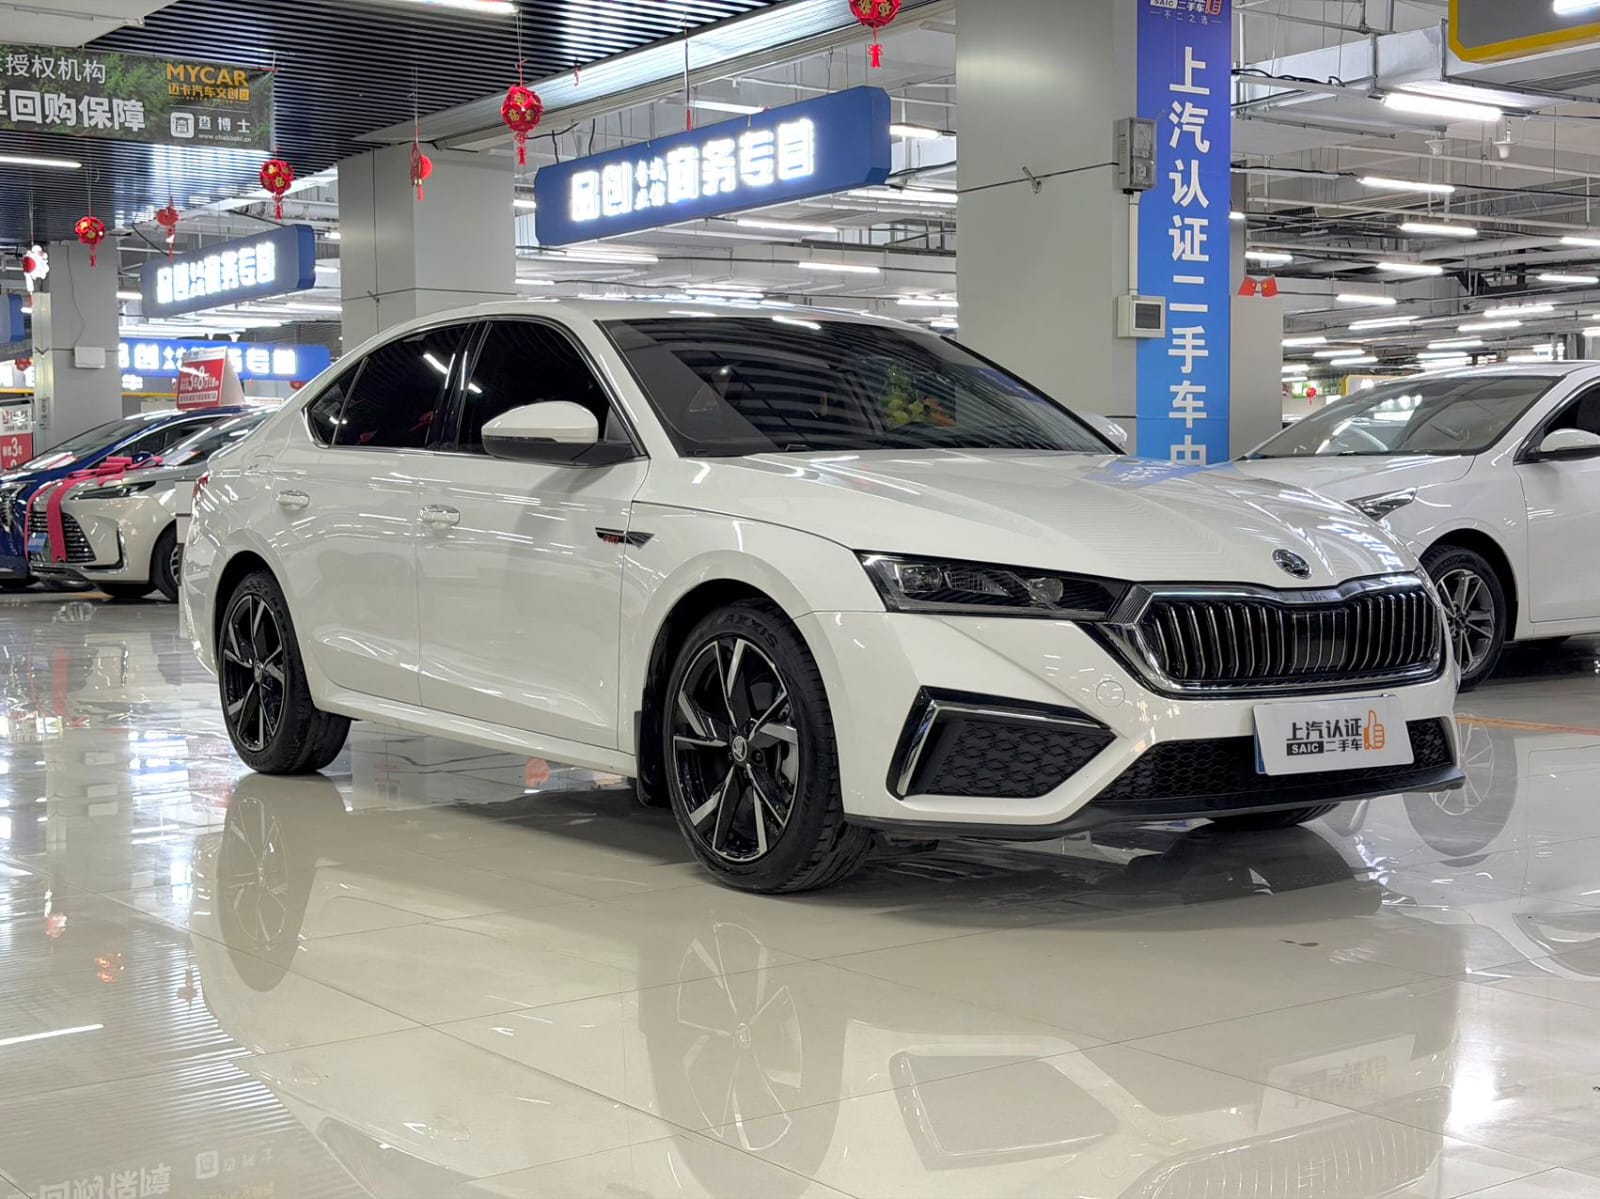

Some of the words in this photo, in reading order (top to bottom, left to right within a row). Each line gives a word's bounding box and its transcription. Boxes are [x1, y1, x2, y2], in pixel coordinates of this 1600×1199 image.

[0, 53, 106, 84] 授权机构
[166, 63, 249, 87] MYCAR
[0, 89, 145, 132] 回购保障
[1286, 718, 1362, 741] 上汽认证
[1289, 743, 1321, 755] SAIC
[1325, 738, 1363, 753] 二手车
